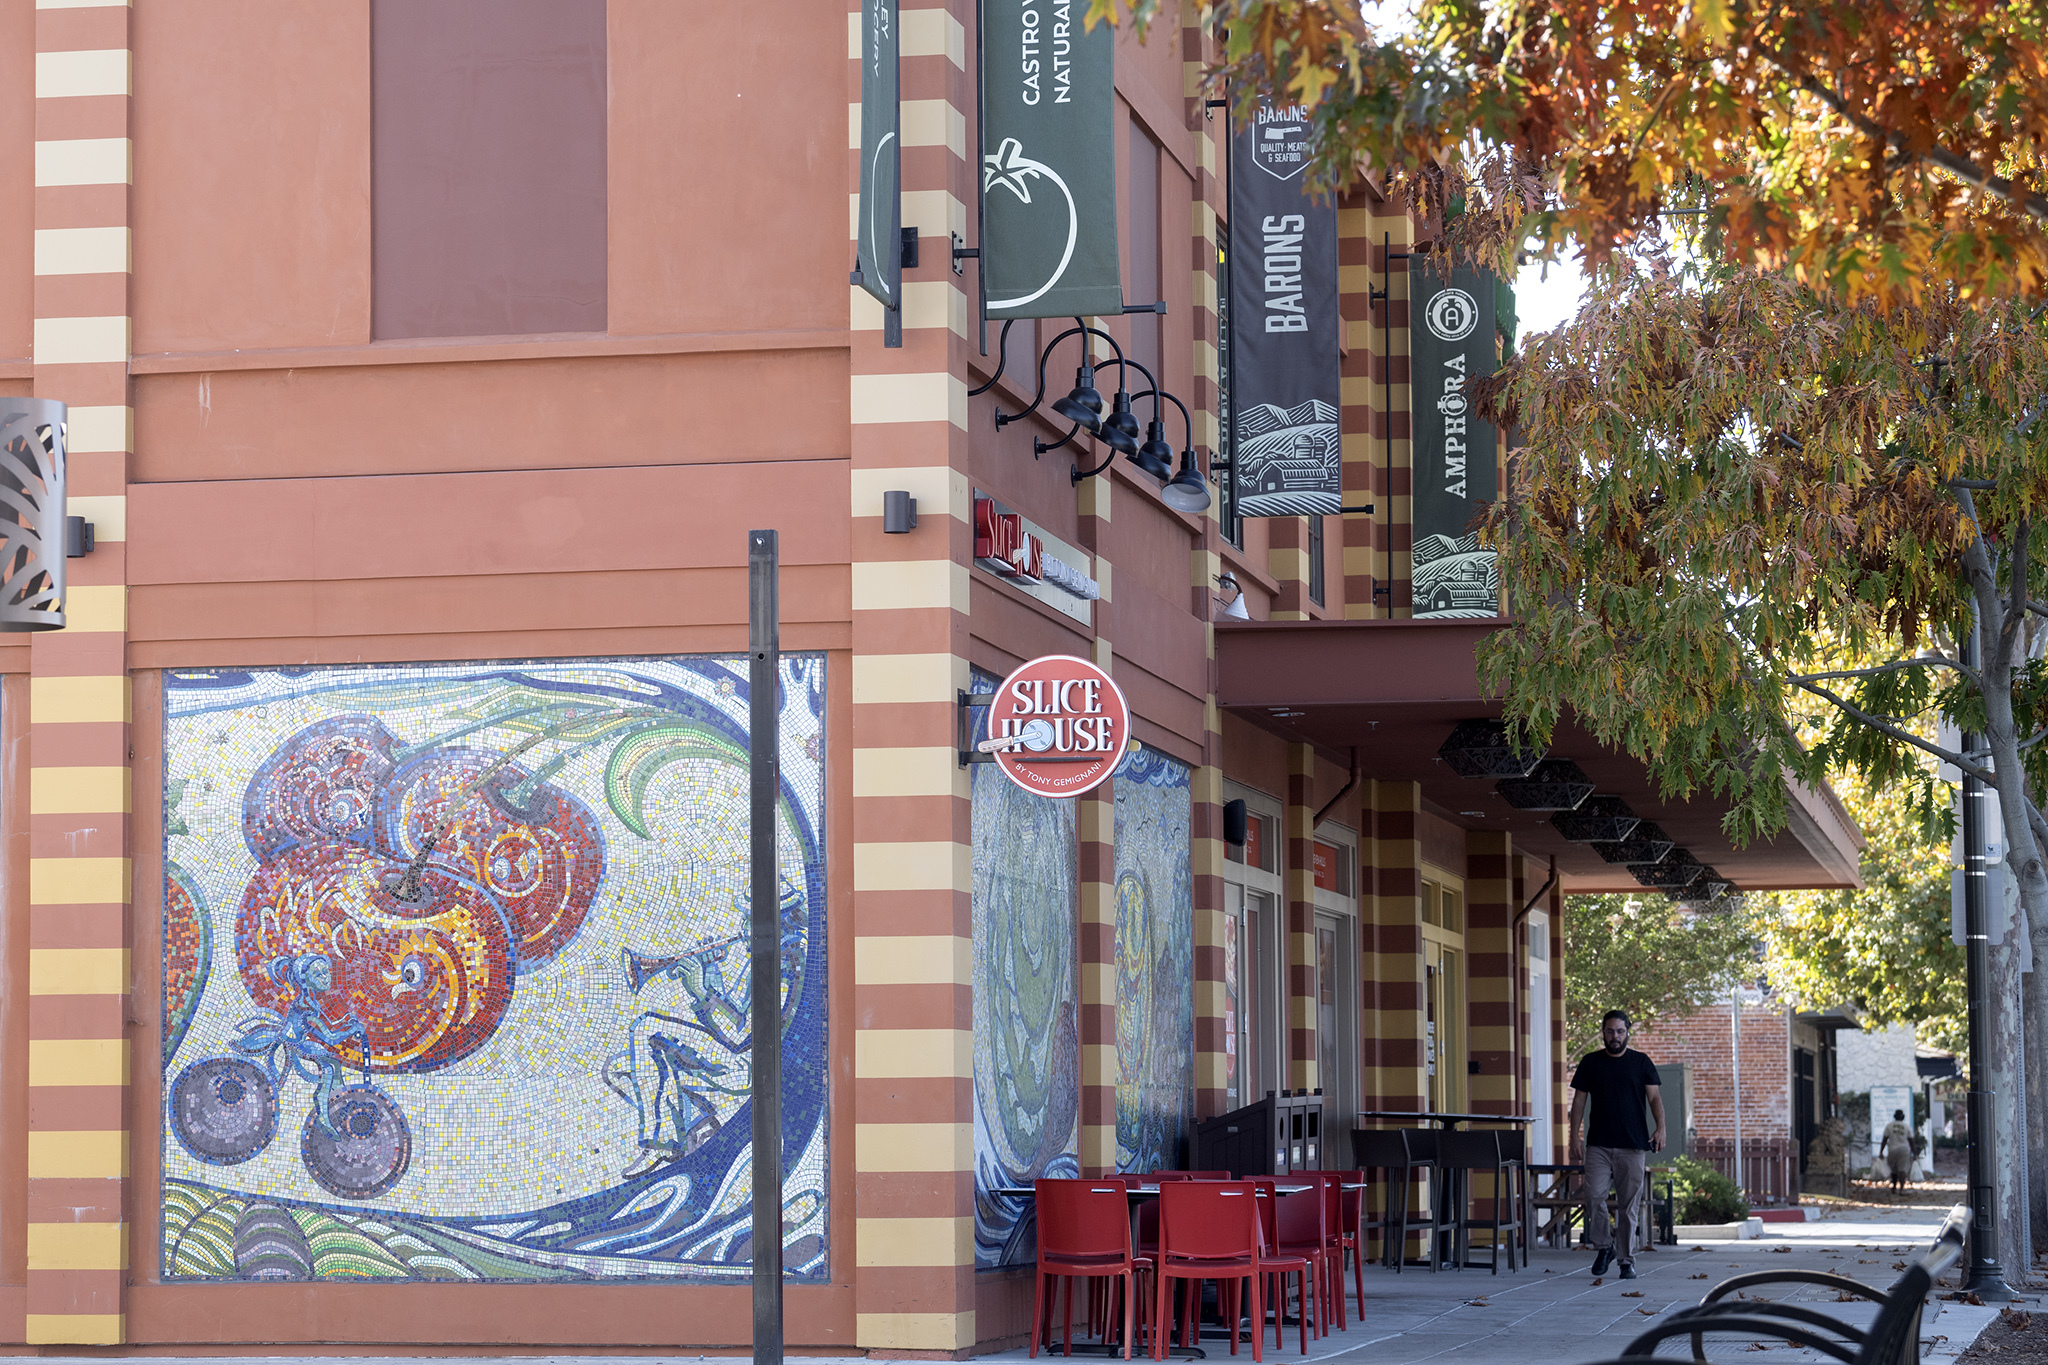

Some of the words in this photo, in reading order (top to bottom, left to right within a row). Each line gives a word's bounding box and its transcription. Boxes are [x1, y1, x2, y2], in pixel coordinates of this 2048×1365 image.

[1022, 9, 1040, 106] CASTRO
[1260, 142, 1285, 153] QUALITY
[1275, 152, 1301, 162] SEAFOOD
[1262, 214, 1308, 332] BARONS
[1437, 353, 1467, 499] AMPHORA
[1011, 678, 1102, 714] SLICE
[1000, 716, 1115, 753] HOUSE
[1015, 762, 1025, 774] BY
[1027, 770, 1051, 786] TONY
[1053, 761, 1102, 787] GEMIGNANI
